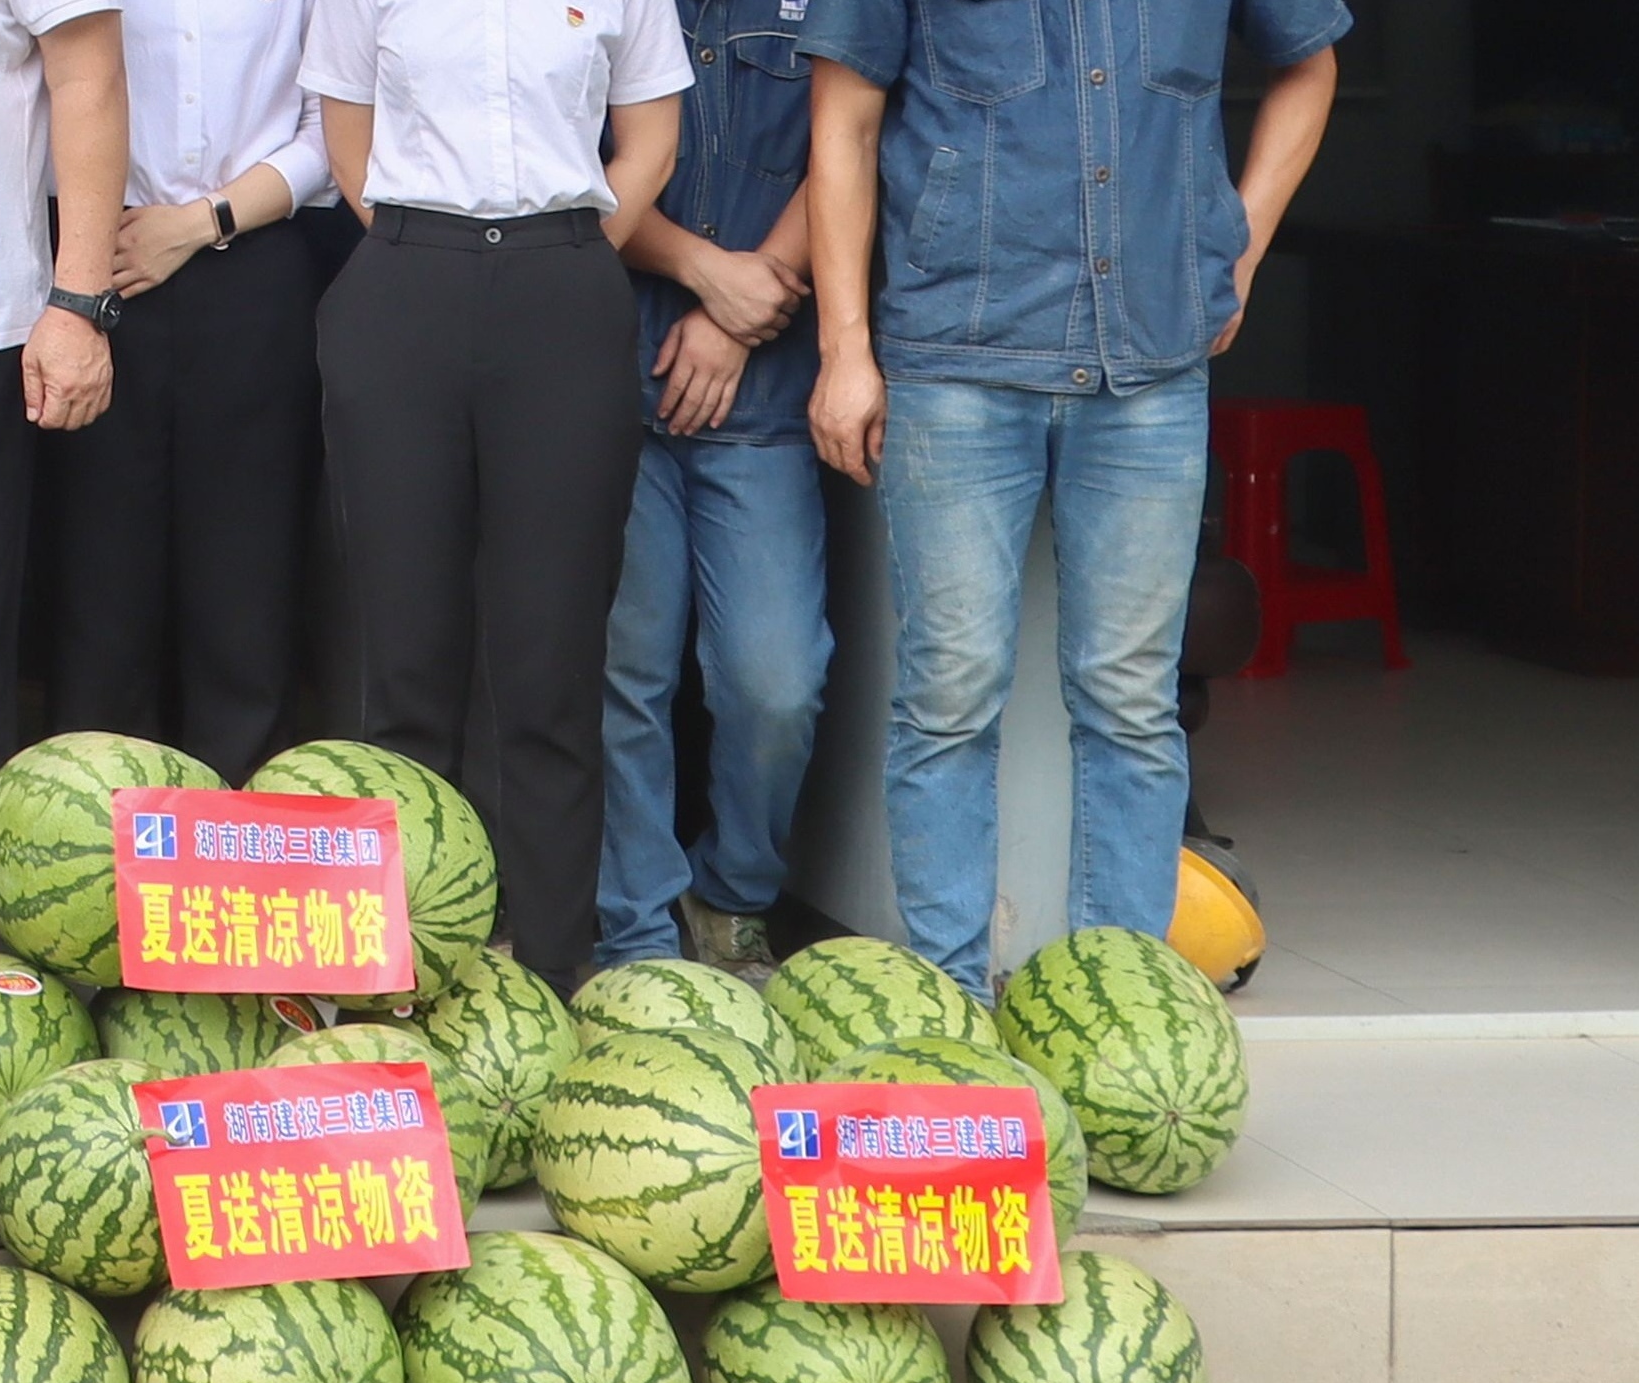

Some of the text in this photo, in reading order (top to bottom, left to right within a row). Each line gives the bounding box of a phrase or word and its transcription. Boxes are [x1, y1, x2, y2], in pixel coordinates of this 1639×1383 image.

[195, 822, 381, 865] 湖南建投三建集团
[139, 884, 384, 966] 夏送清凉物资
[226, 1090, 423, 1142] 湖南建投三建集团
[839, 1117, 1025, 1157] 湖南建投三建集团
[175, 1159, 437, 1259] 夏送清凉物资
[785, 1185, 1032, 1274] 夏送清凉物资
